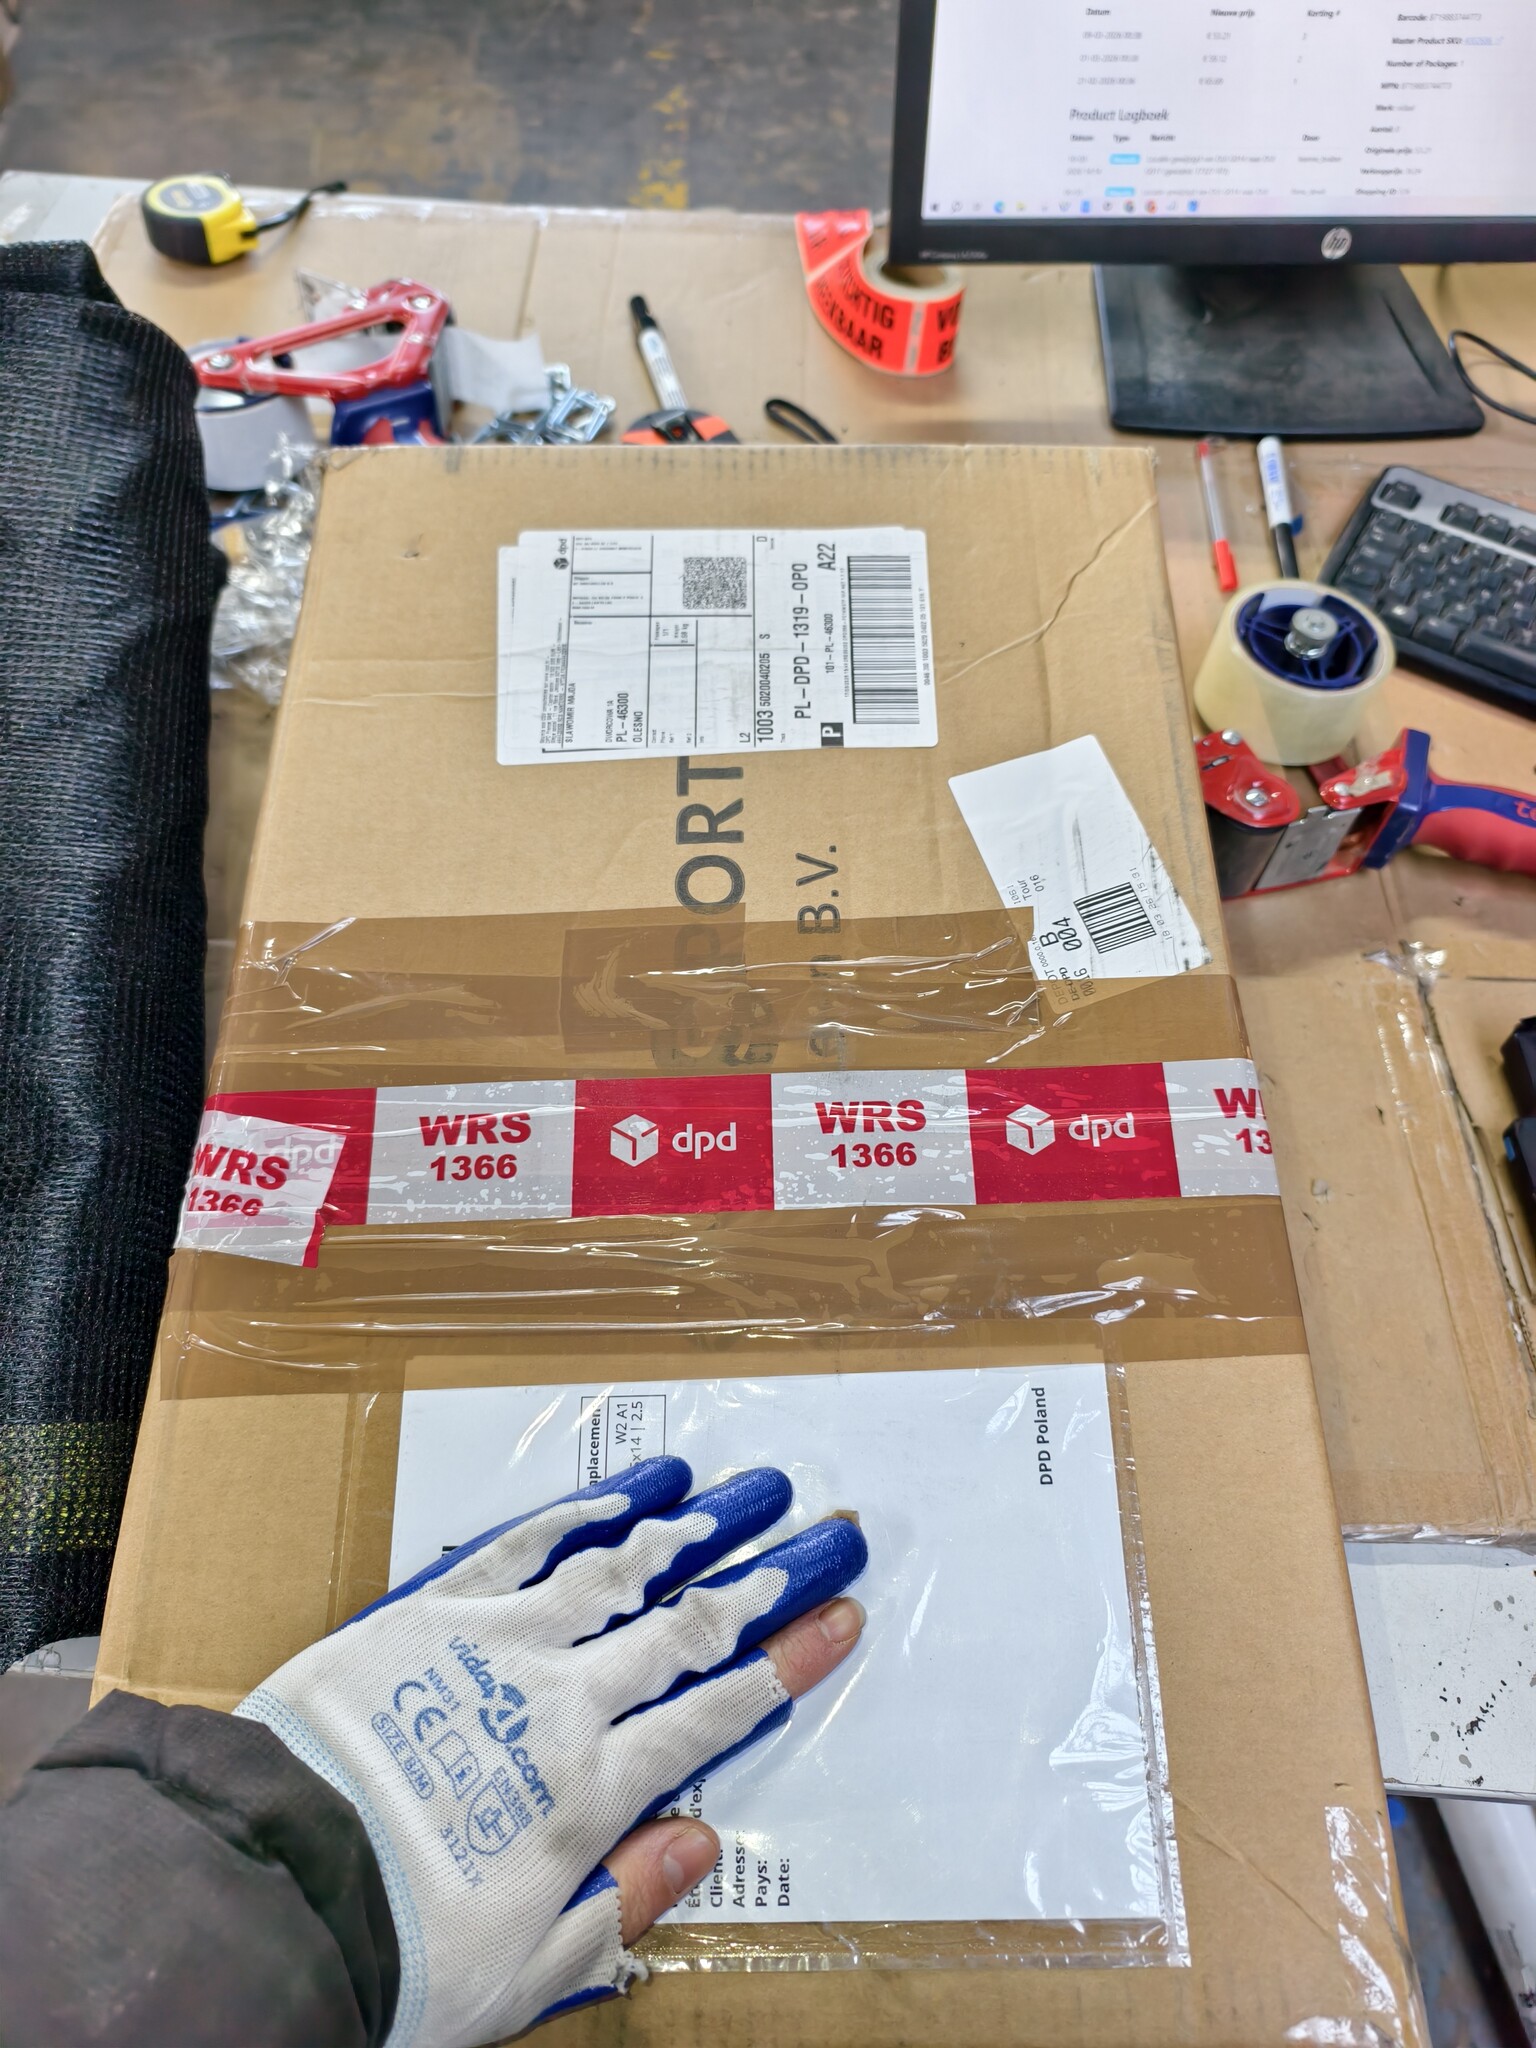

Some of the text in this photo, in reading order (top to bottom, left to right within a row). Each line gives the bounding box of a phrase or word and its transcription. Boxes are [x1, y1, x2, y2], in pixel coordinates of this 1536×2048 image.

[1069, 108, 1169, 124] Product Logboek
[556, 538, 569, 556] dpd
[817, 543, 836, 571] A22
[759, 653, 771, 707] 5020040205
[564, 707, 575, 743] SLAWOMIR
[632, 711, 643, 743] OLESNO
[739, 732, 750, 743] L2
[757, 710, 773, 744] 1003
[797, 845, 841, 934] B.V.
[1017, 879, 1033, 902] Tour
[1029, 874, 1045, 892] 016
[1039, 931, 1060, 948] B
[1043, 968, 1069, 1006] DEPOT
[814, 1099, 927, 1135] WRS
[1213, 1087, 1266, 1119] W
[419, 1112, 532, 1147] WRS
[671, 1121, 738, 1160] dpd
[1067, 1111, 1136, 1148] dpd
[193, 1143, 290, 1191] WRS
[428, 1153, 519, 1182] 1366
[830, 1142, 918, 1168] 1366
[615, 1403, 628, 1445] W2 A1
[630, 1401, 643, 1467] x14 2.5
[1031, 1387, 1053, 1485] DPD Poland
[376, 1716, 406, 1757] SIZE
[755, 1860, 771, 1907] Pays:
[777, 1858, 790, 1907] Date:
